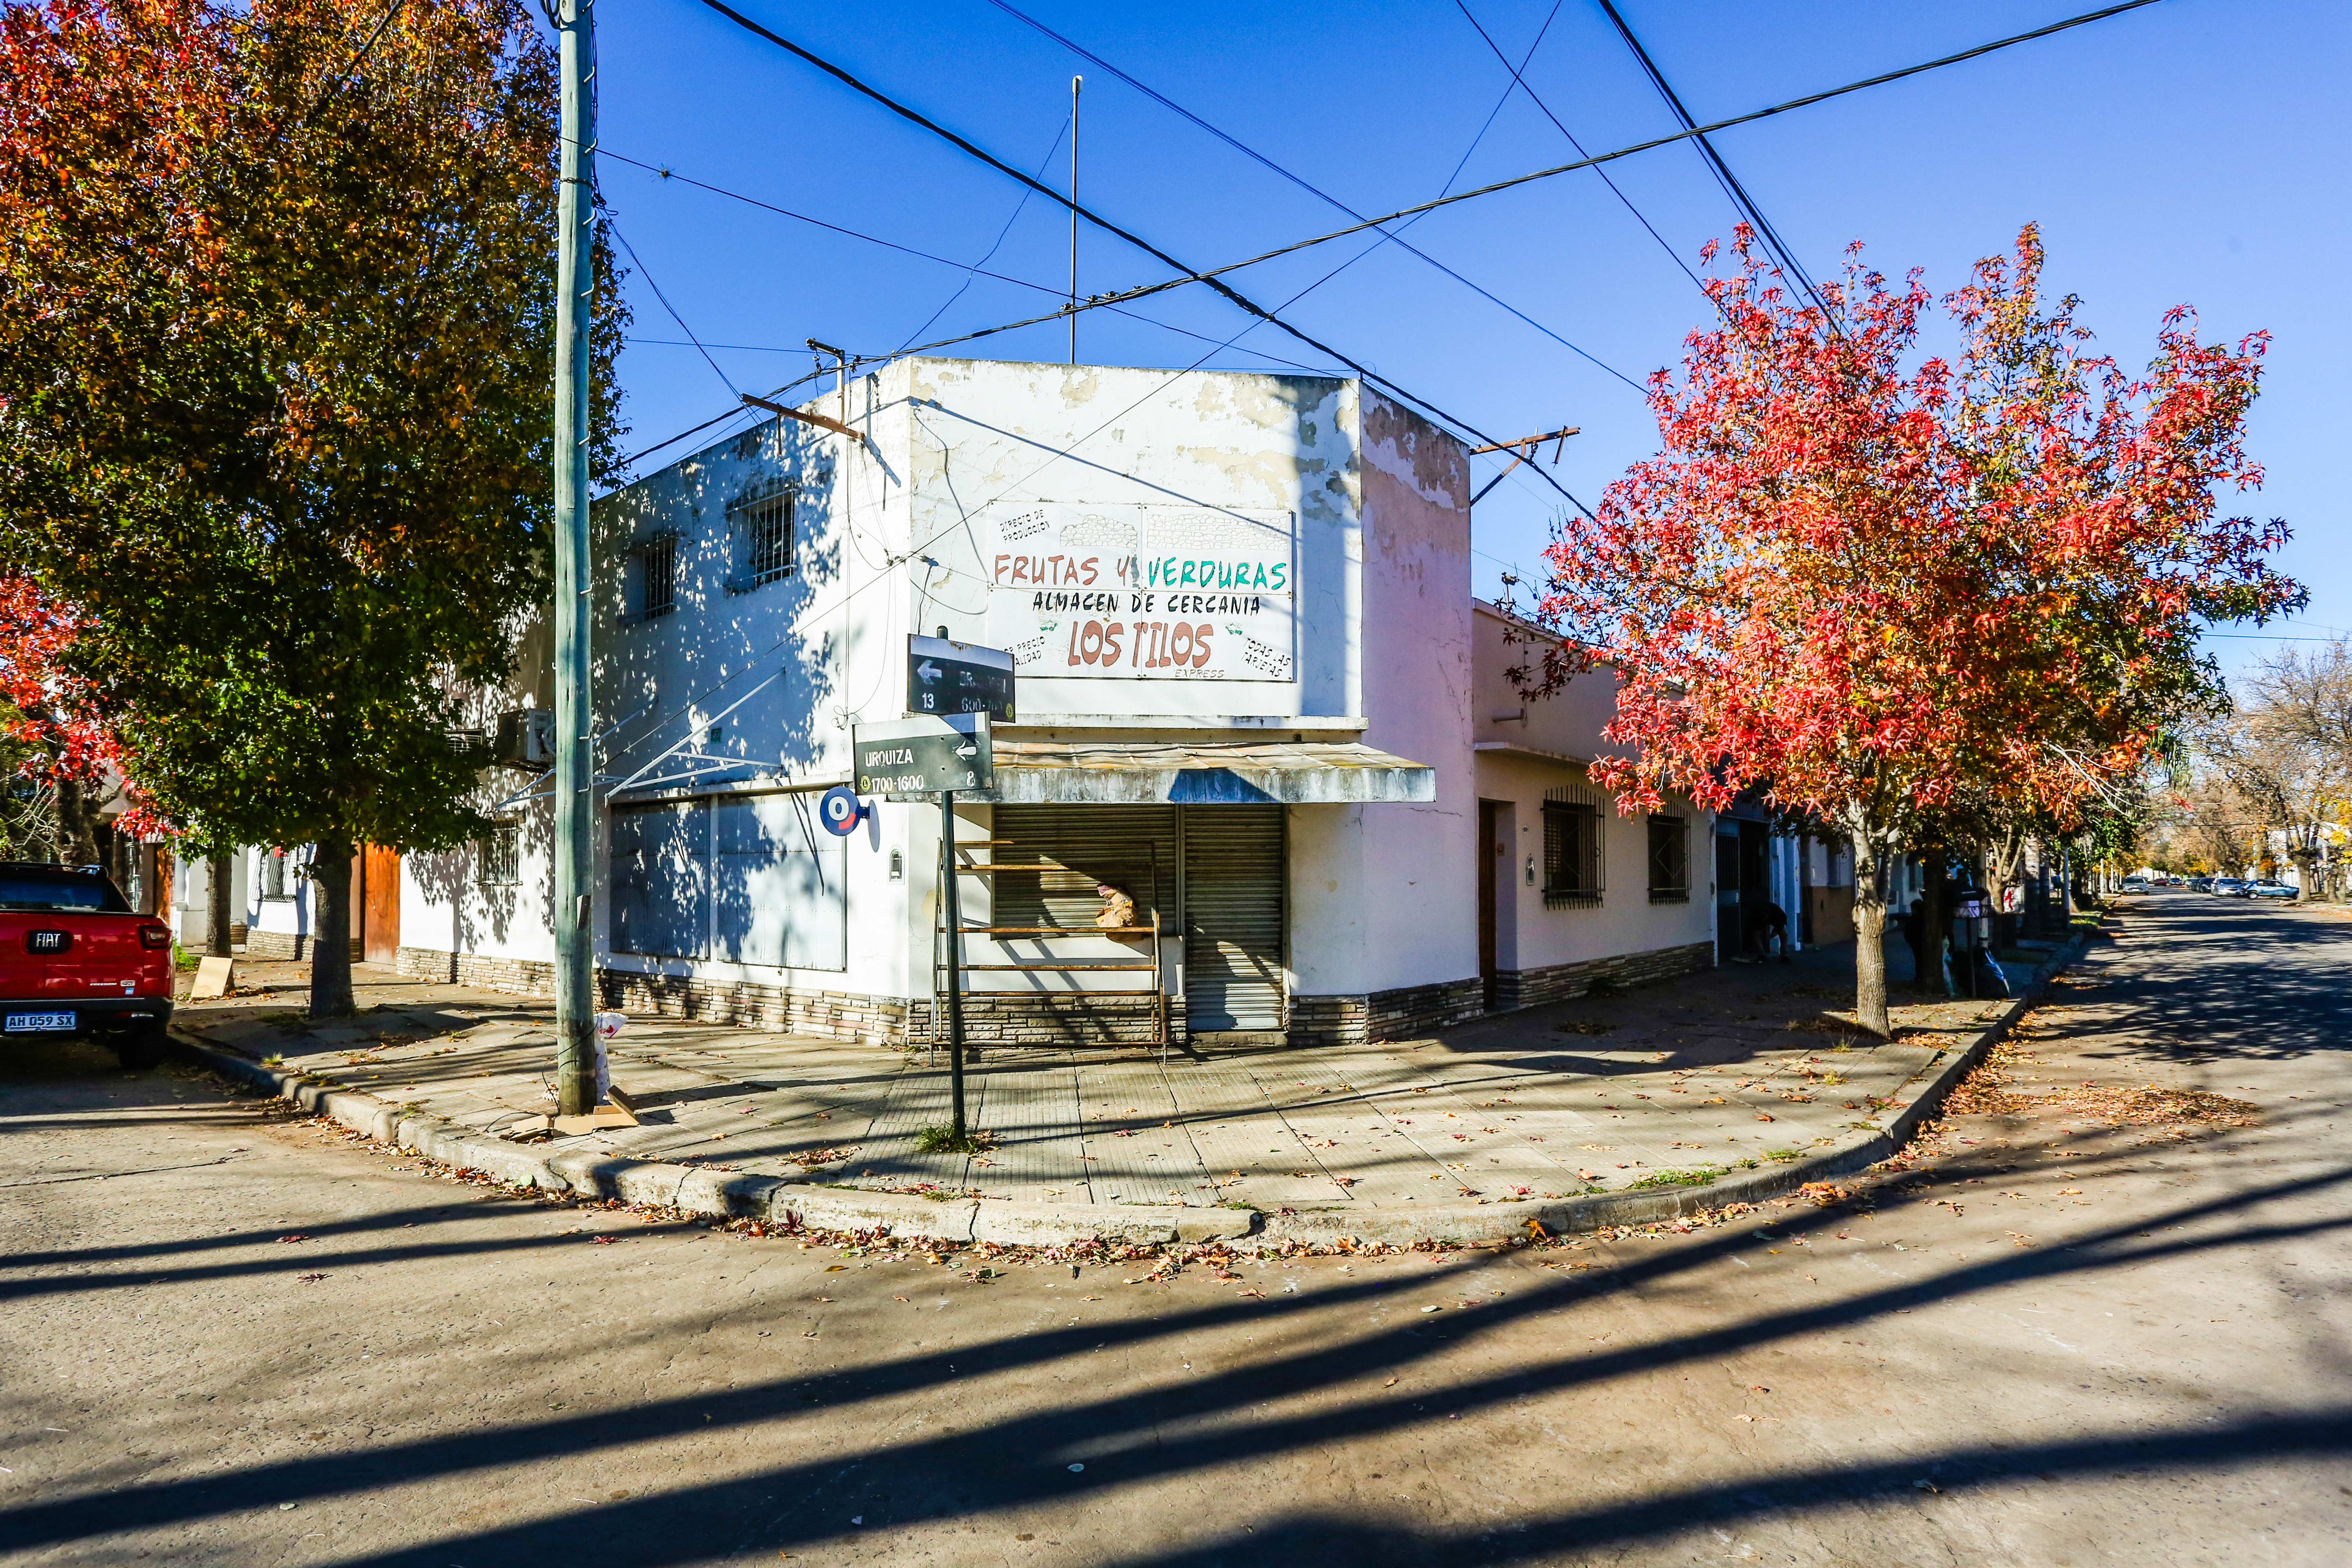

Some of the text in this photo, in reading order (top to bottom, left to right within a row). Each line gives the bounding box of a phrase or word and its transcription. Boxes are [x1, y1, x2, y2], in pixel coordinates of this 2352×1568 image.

[1000, 509, 1044, 532] DIRECTO DE
[1003, 520, 1050, 544] PRODUCCION
[995, 554, 1287, 590] FRUTAS Y VERDURAS
[1033, 591, 1261, 616] ALMACEN DE CERCANIA
[1017, 636, 1045, 653] PRECIO
[1068, 620, 1214, 668] LOS TILOS
[1243, 637, 1291, 666] TODAS LAS
[1015, 650, 1042, 667] ALIDAD
[1241, 651, 1283, 677] TARJETAS
[1175, 669, 1225, 678] EXPRESS
[922, 692, 934, 709] 13
[864, 748, 914, 768] URQUIZA
[966, 770, 976, 788] 8
[36, 933, 61, 947] FIAT
[9, 1015, 73, 1027] AH 059 SX
